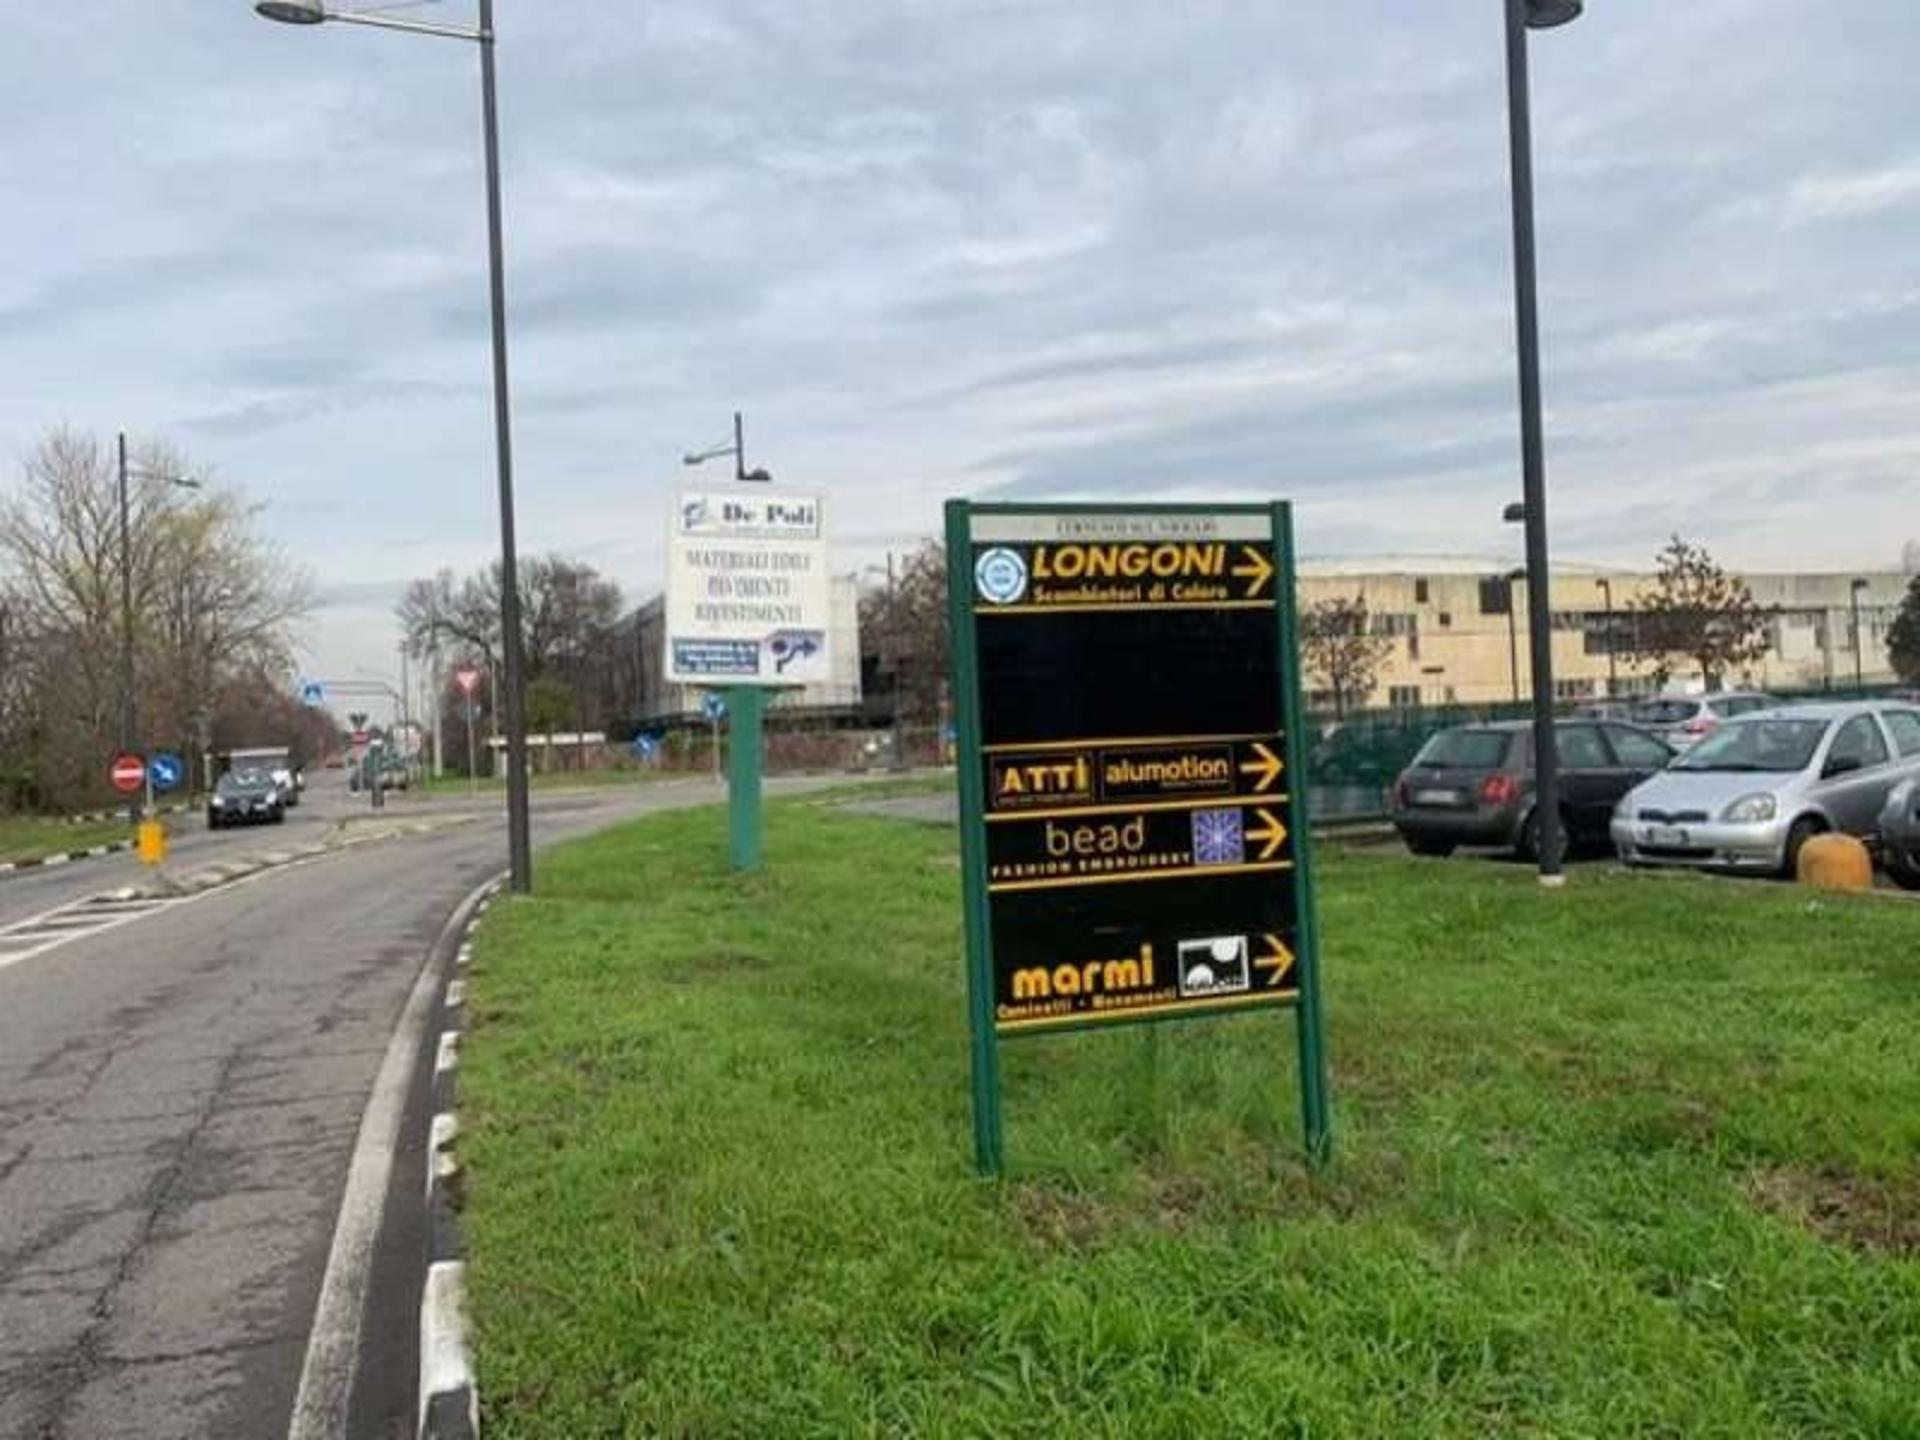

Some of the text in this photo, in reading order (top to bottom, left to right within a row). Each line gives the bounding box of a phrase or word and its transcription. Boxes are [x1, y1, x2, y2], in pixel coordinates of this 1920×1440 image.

[722, 503, 756, 522] De
[1032, 545, 1226, 578] LONGONI
[1150, 582, 1166, 599] di
[1105, 756, 1228, 784] alumotion
[1045, 816, 1145, 856] bead
[992, 863, 1072, 879] FASHION
[1012, 943, 1154, 999] marmi
